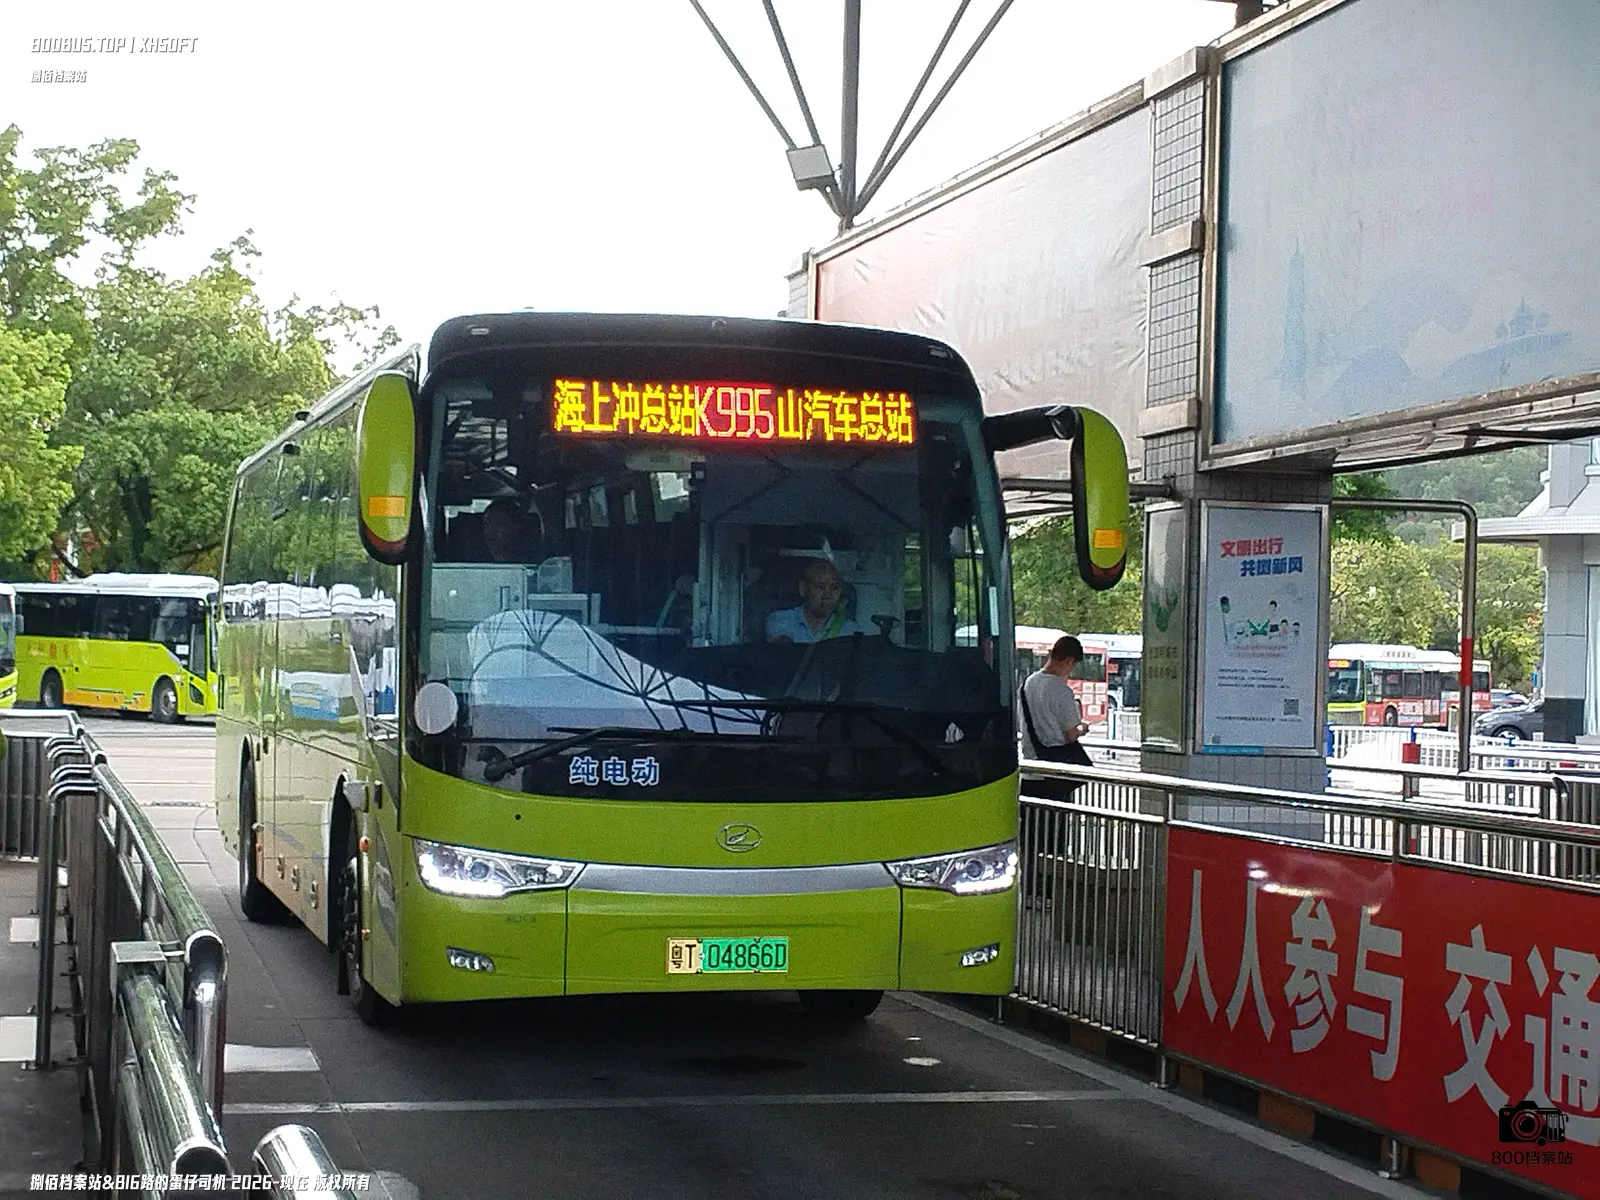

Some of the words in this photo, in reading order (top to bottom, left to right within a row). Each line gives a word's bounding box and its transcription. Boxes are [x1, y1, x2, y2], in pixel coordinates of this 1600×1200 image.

[568, 756, 661, 786] 纯电动
[1173, 869, 1405, 1082] 人人参与
[1443, 923, 1600, 1148] 交通
